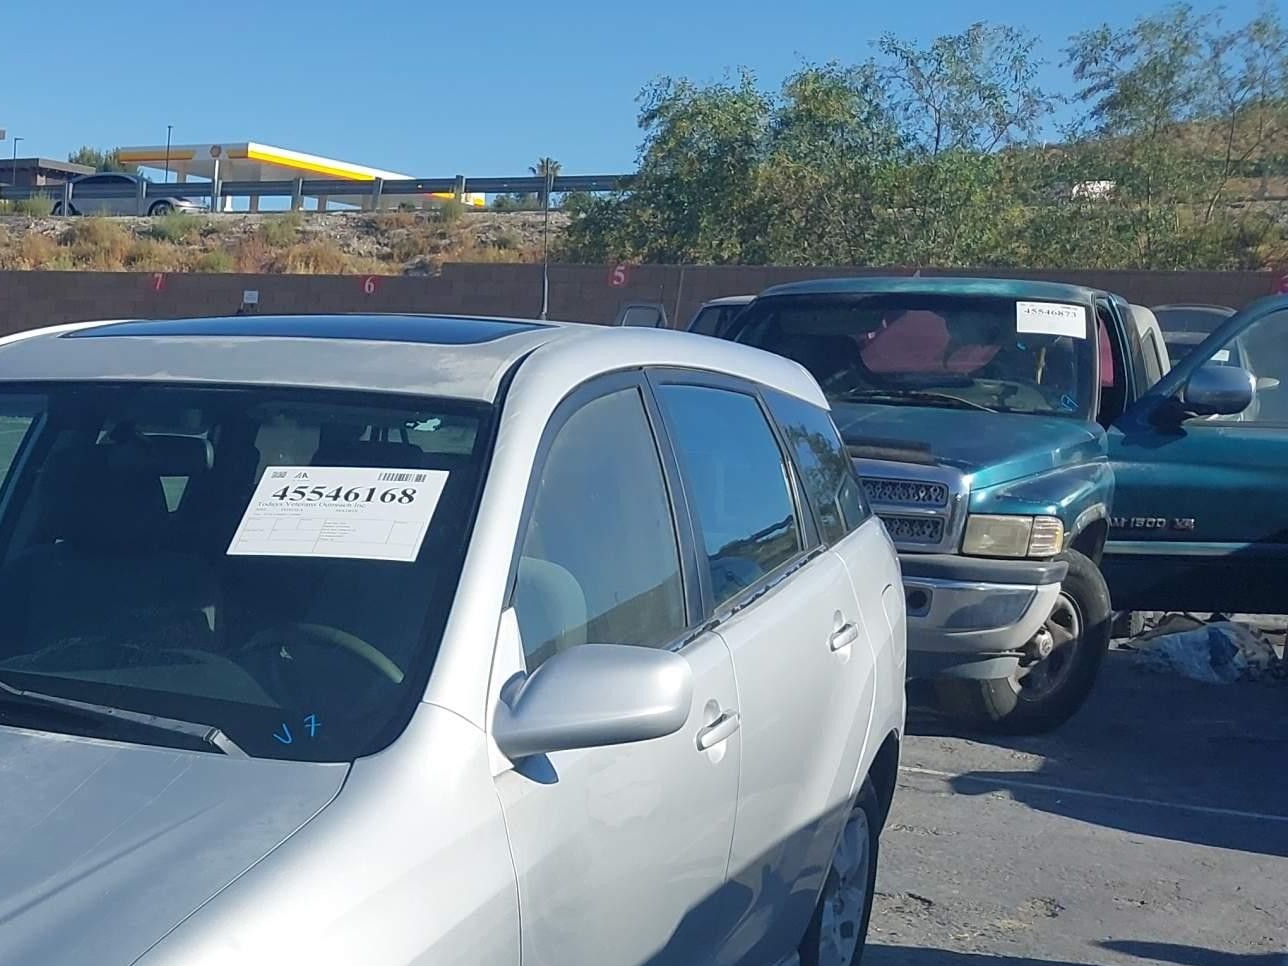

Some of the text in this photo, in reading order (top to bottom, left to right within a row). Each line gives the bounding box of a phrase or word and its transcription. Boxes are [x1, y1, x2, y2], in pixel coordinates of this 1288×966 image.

[364, 275, 376, 294] 6
[612, 265, 626, 286] 5
[271, 485, 418, 505] 45546168
